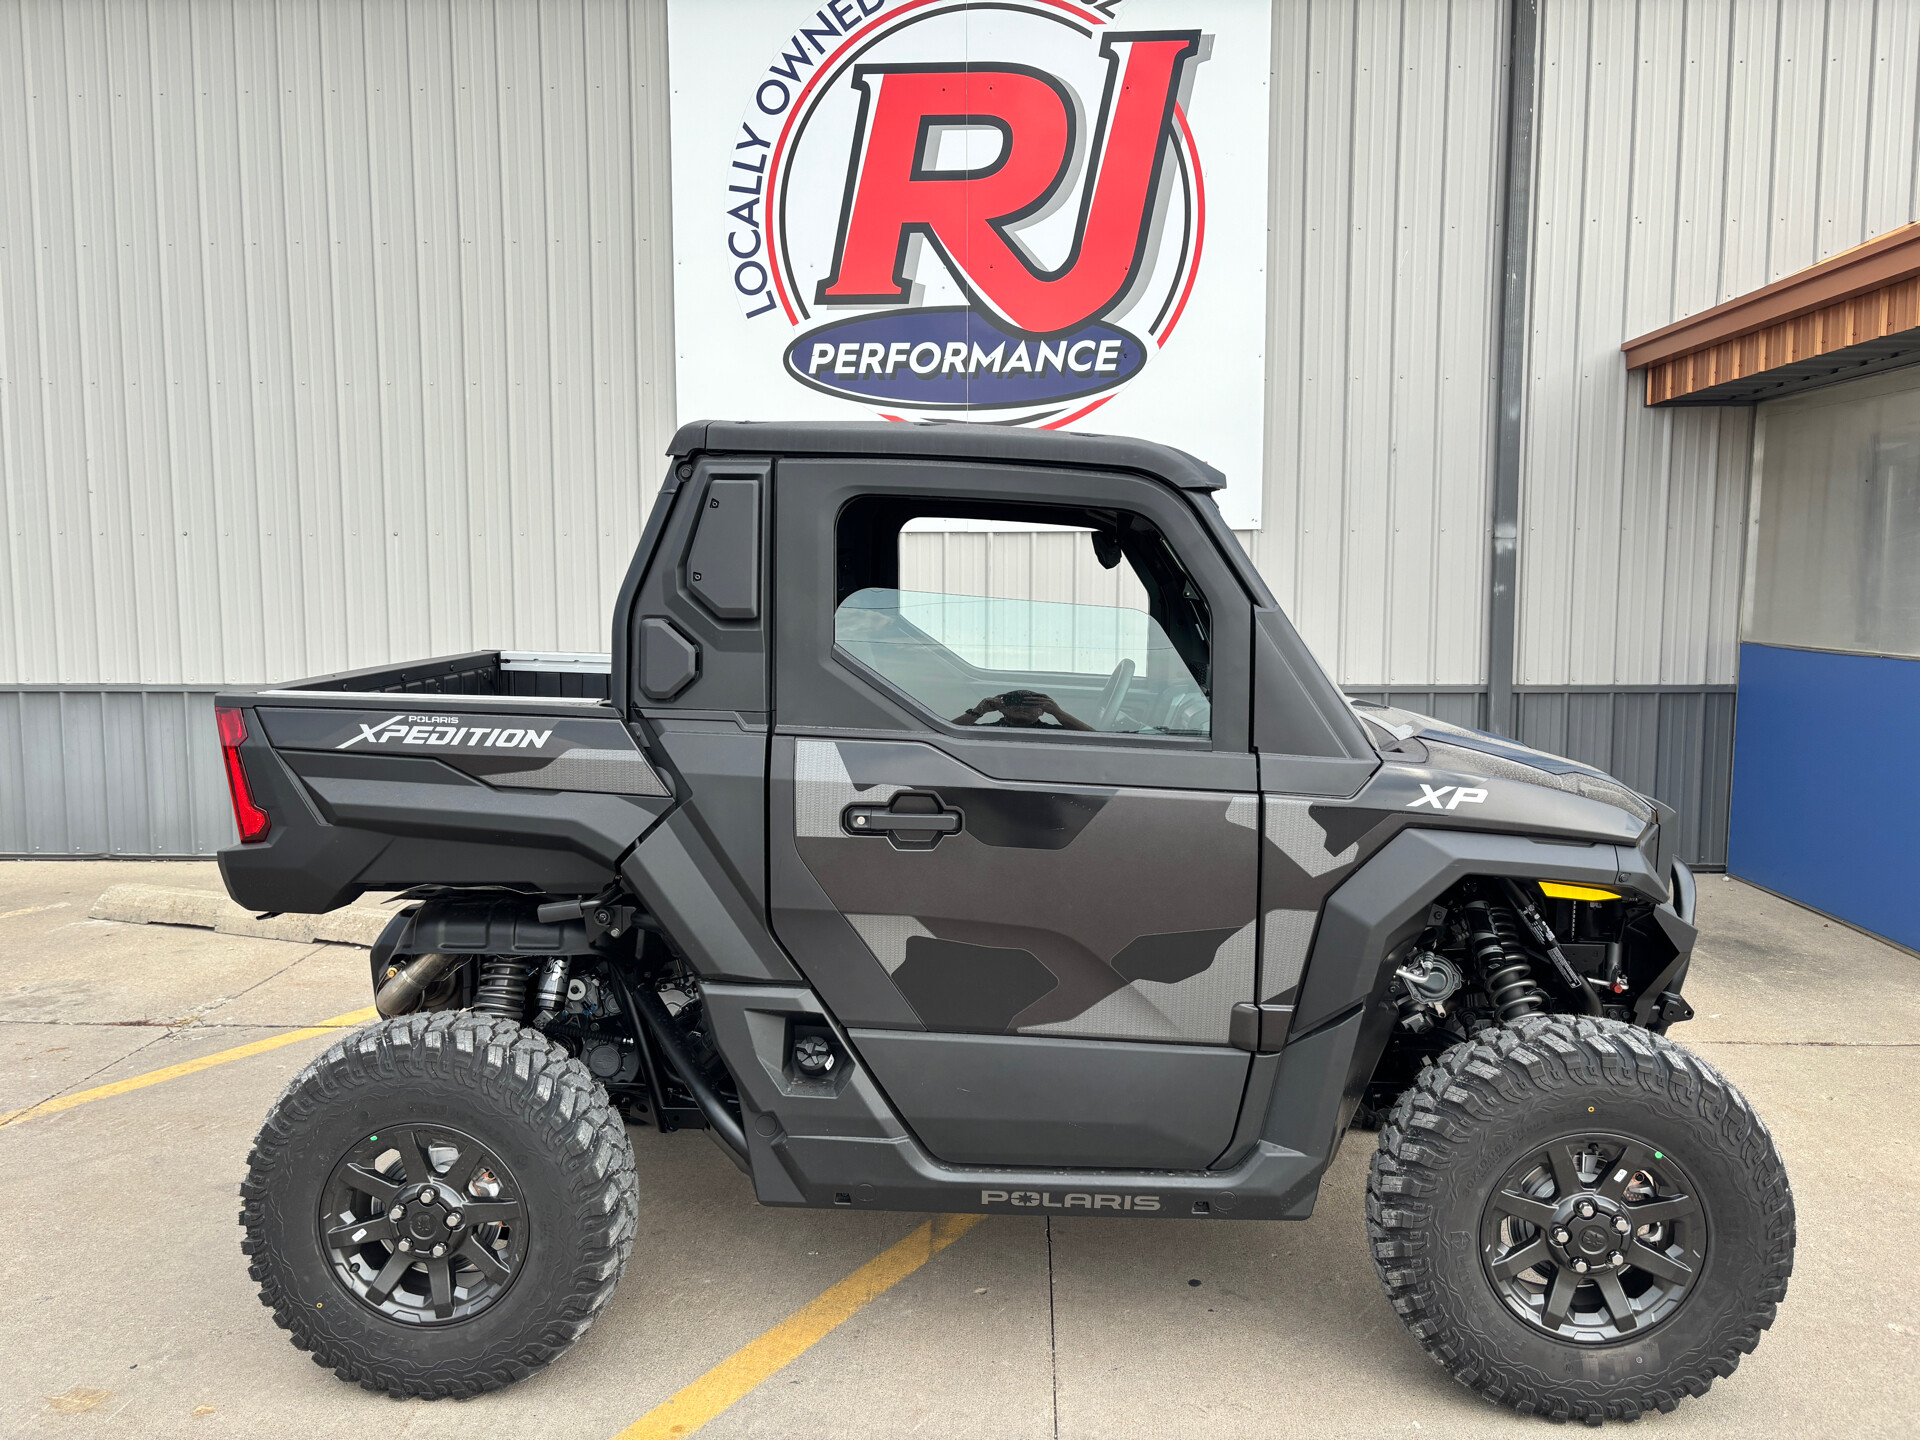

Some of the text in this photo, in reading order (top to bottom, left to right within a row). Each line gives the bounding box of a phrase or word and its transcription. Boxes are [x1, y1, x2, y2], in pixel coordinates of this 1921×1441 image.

[813, 28, 1202, 339] RJ
[726, 122, 777, 320] LOCALLY
[808, 338, 1122, 375] PERFORMANCE
[335, 715, 553, 749] XPEDITION
[408, 715, 459, 724] POLARIS
[1406, 783, 1489, 810] XP
[980, 1189, 1161, 1211] POLARIS
